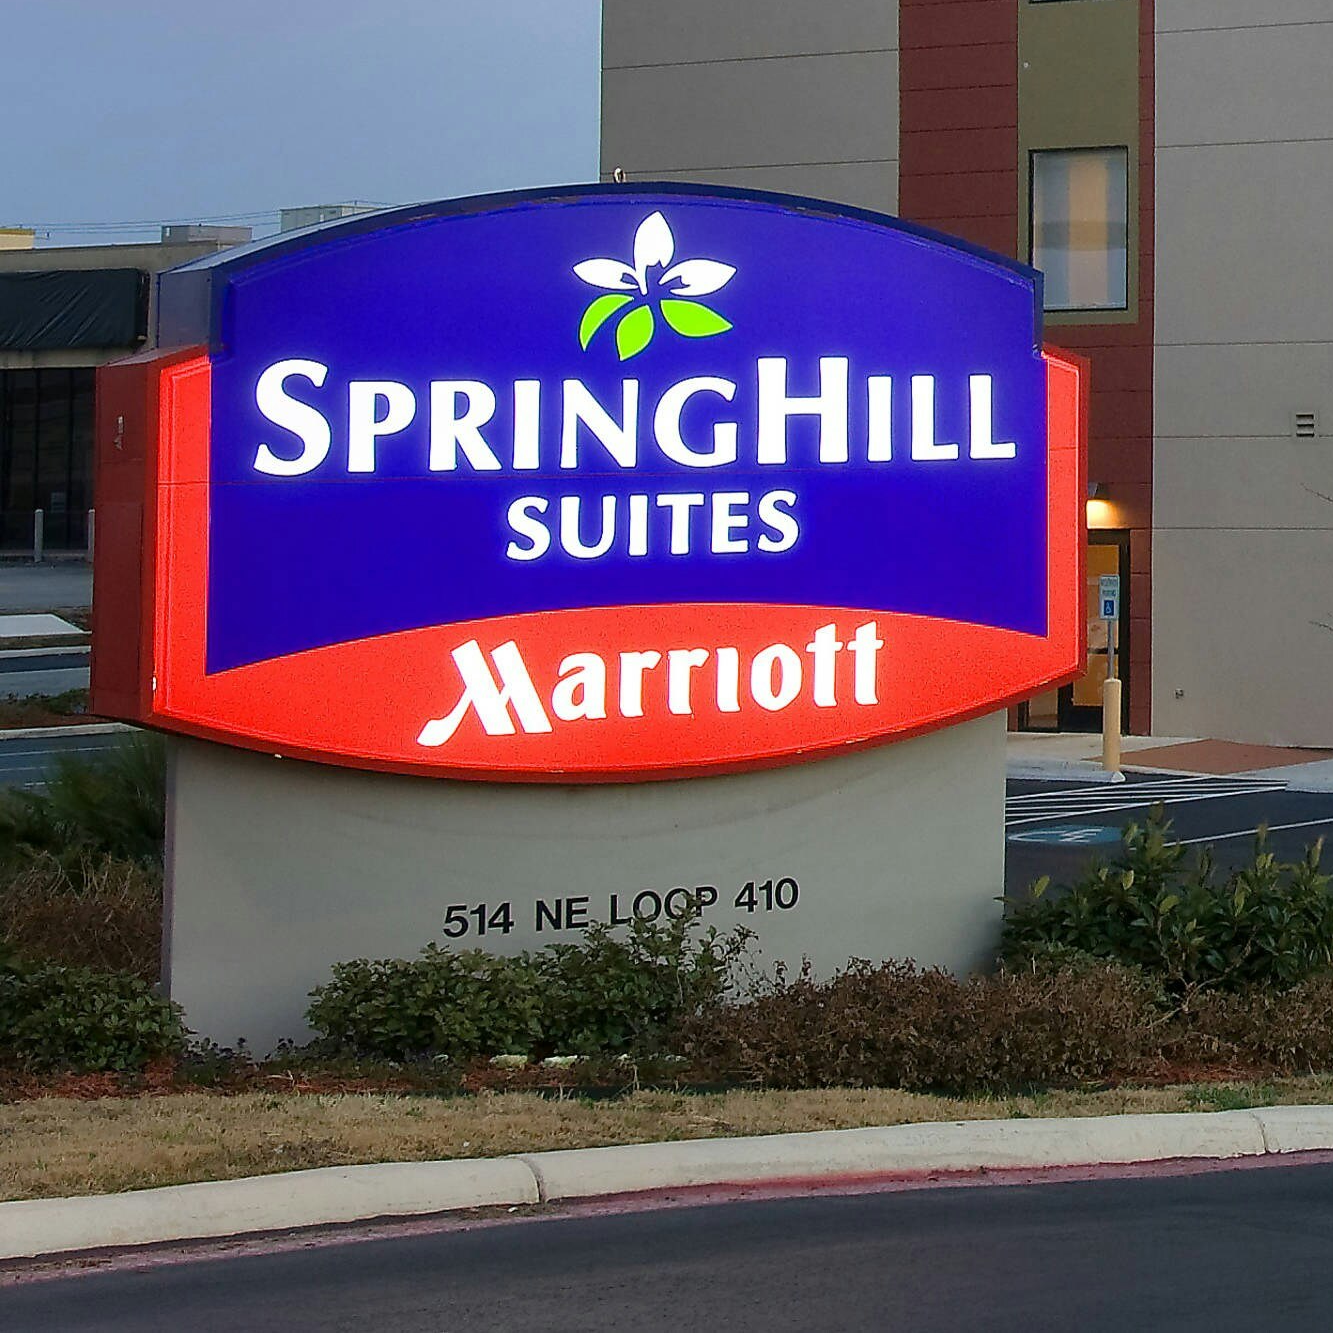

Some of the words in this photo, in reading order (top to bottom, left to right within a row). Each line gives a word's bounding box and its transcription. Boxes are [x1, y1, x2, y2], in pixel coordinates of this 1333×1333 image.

[252, 356, 1017, 478] SPRINGHILL
[505, 489, 800, 561] SUITES
[415, 621, 885, 748] Marriott
[443, 902, 515, 939] 514
[535, 896, 591, 932] NE
[610, 885, 719, 926] LOOP
[734, 877, 800, 913] 410
